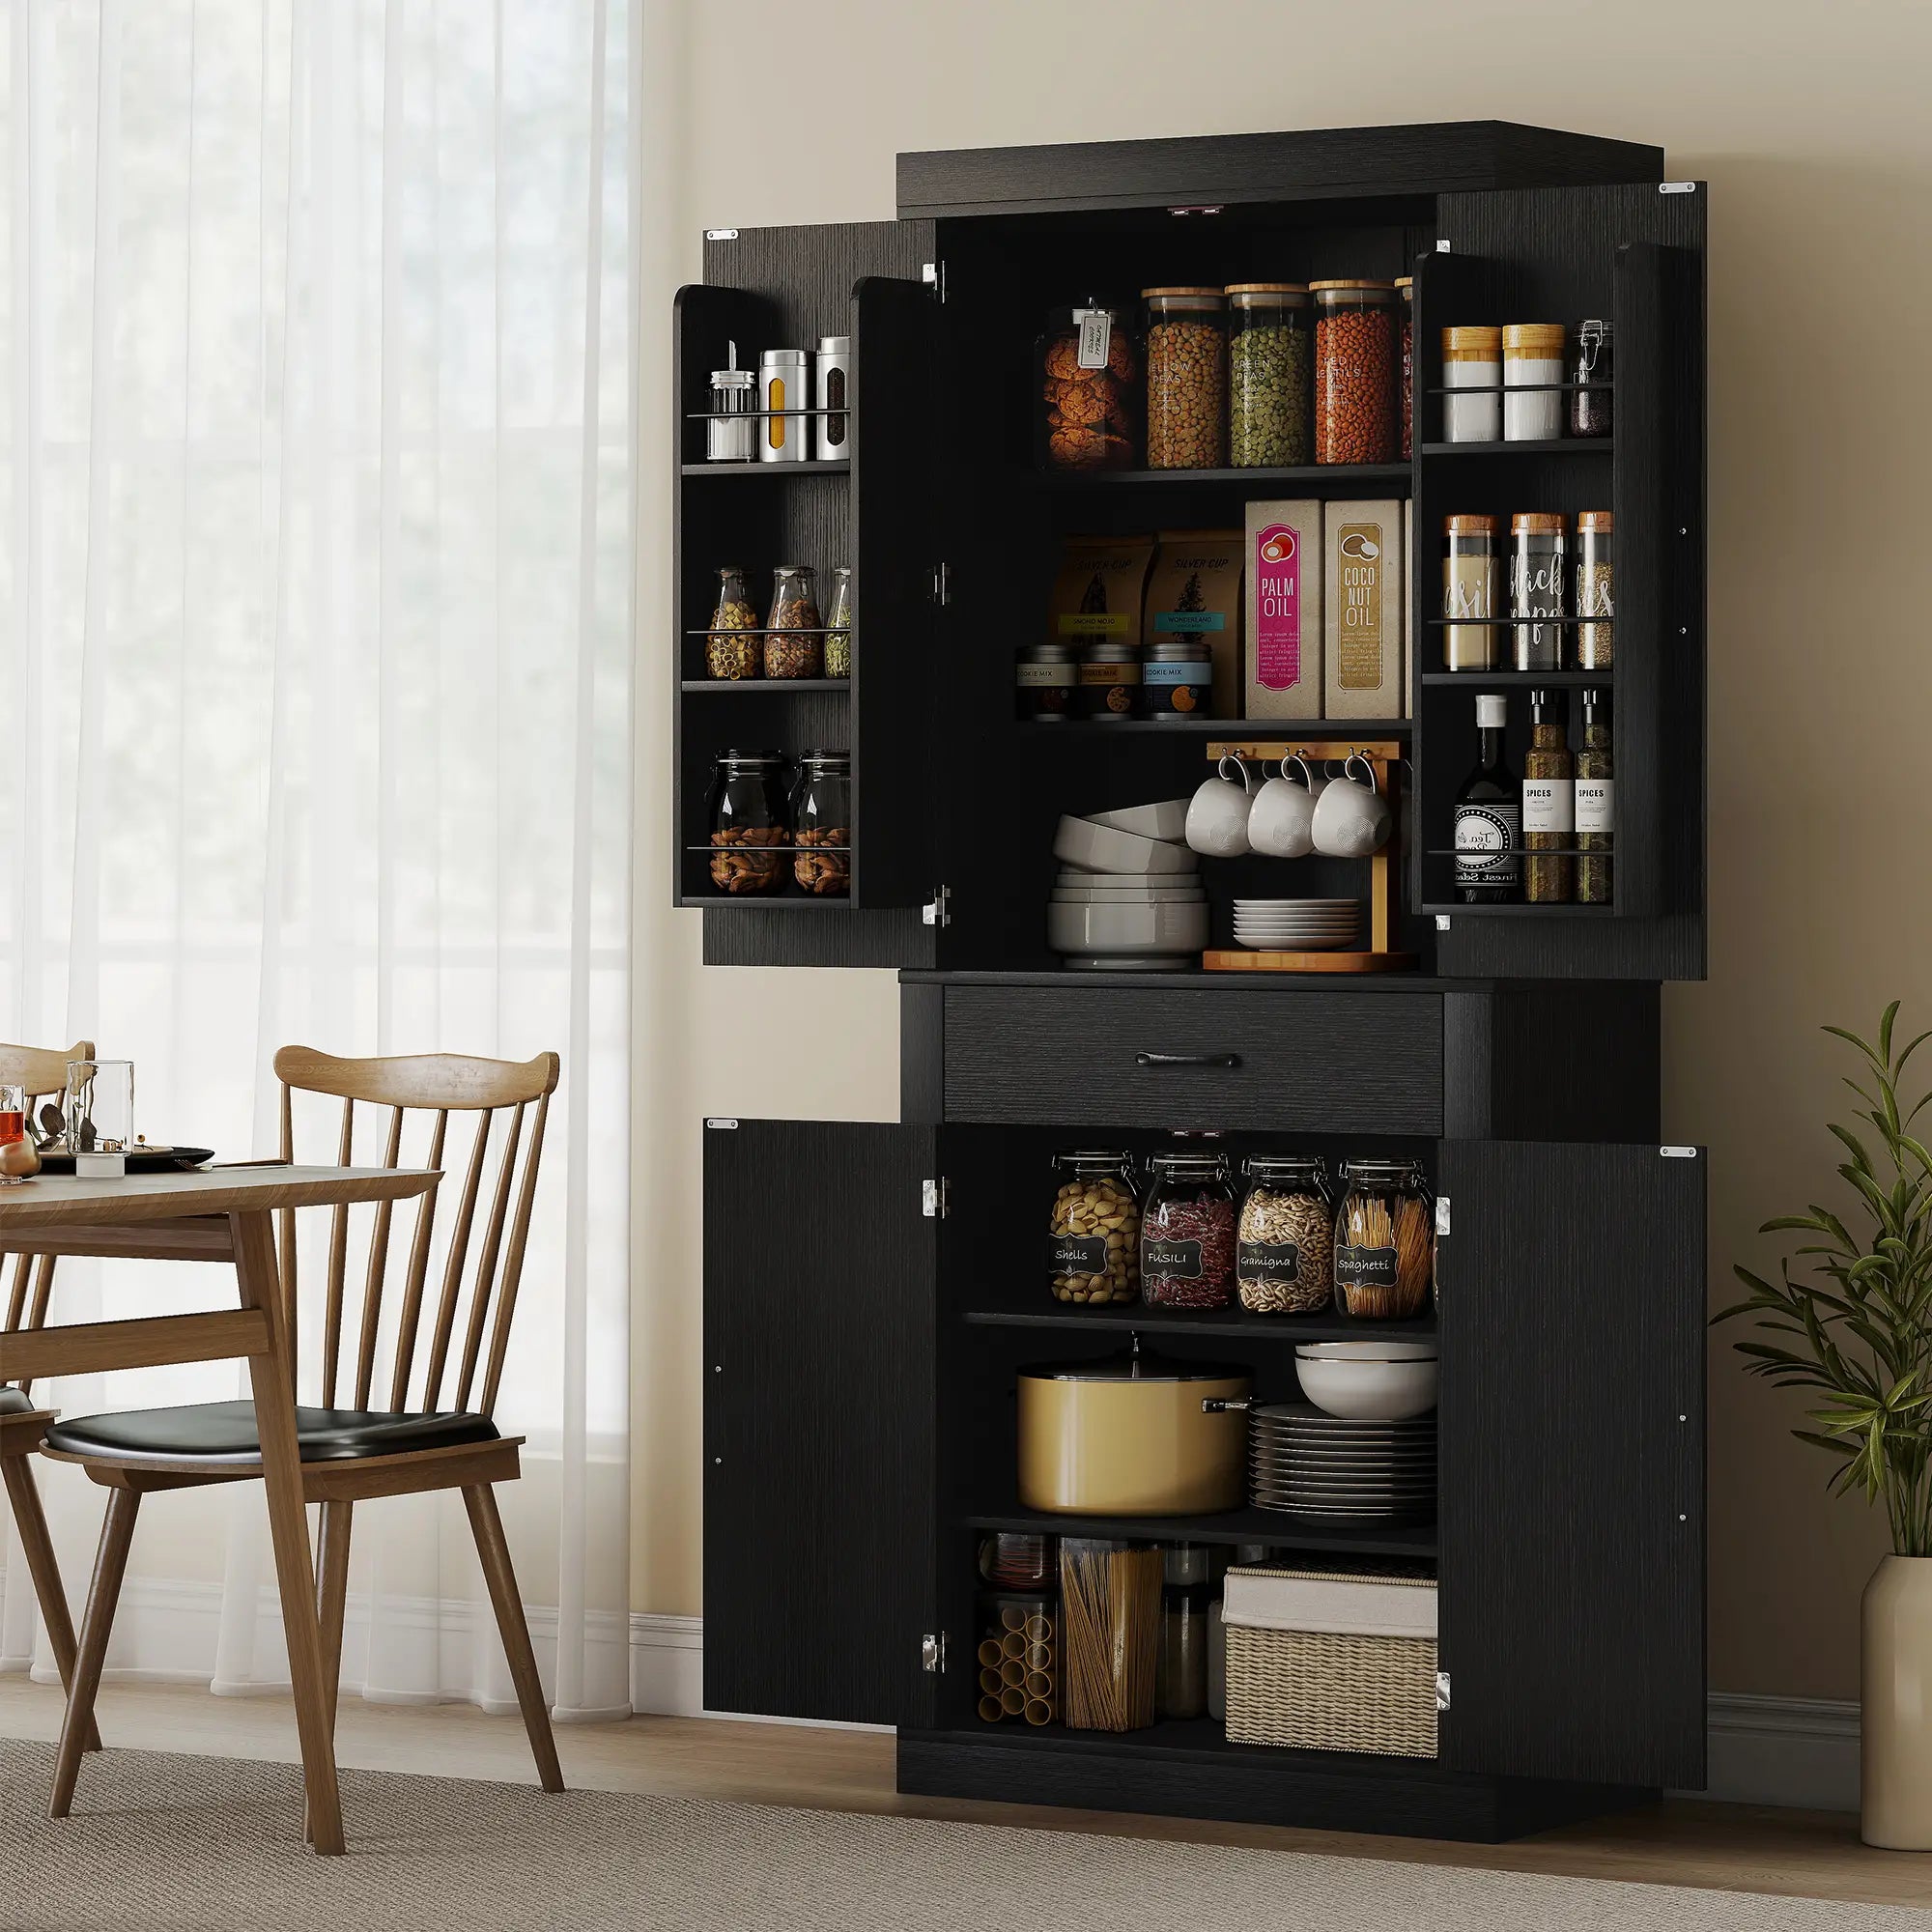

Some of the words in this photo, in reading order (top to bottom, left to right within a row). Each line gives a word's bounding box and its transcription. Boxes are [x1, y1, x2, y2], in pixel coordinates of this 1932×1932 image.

[1323, 355, 1348, 366] RED
[1152, 375, 1181, 384] PEAS
[1236, 372, 1265, 382] PEAS
[1316, 368, 1362, 379] LETILS
[1175, 558, 1207, 569] SILVER
[1208, 558, 1229, 569] CUP
[1345, 567, 1375, 586] COCO
[1262, 578, 1293, 597] PALM
[1349, 587, 1372, 606] NUT
[1264, 597, 1293, 617] OIL
[1346, 607, 1375, 627] OIL
[1526, 788, 1552, 798] SPICES
[1578, 788, 1605, 798] SPICES
[1054, 1249, 1089, 1261] Shells
[1240, 1256, 1292, 1269] Gramigna
[1338, 1259, 1391, 1273] Spaghetti
